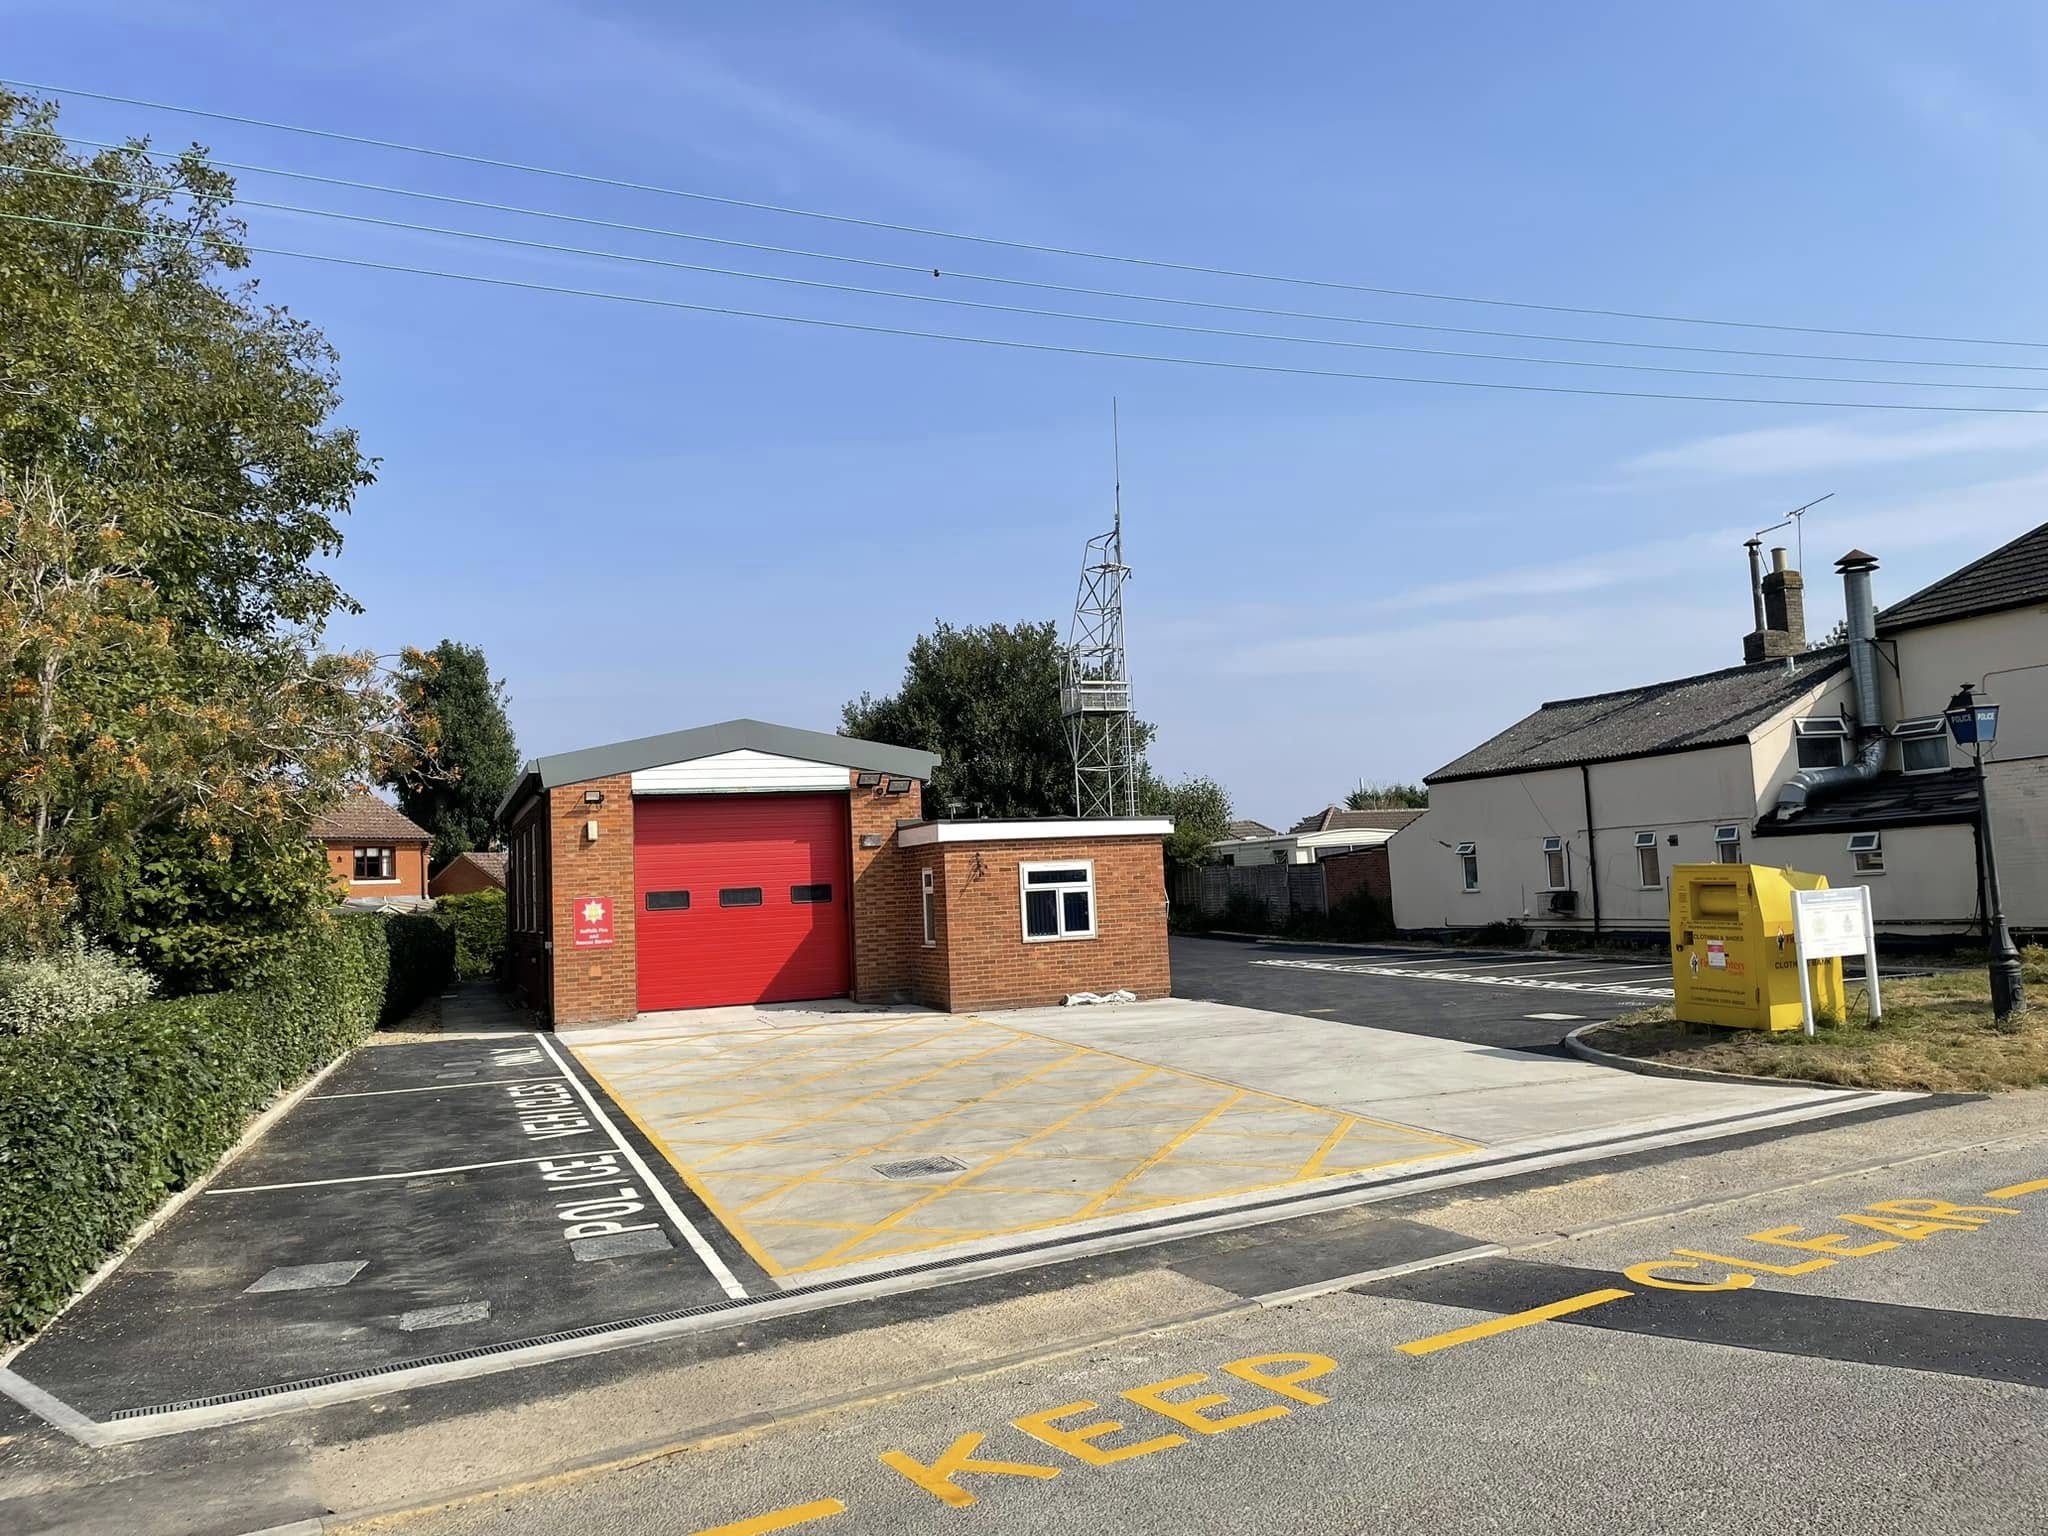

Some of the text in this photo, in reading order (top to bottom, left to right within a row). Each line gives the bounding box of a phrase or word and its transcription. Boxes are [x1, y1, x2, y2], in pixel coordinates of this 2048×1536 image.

[1952, 714, 1971, 723] POLICE
[1977, 712, 1995, 720] POLICE
[489, 1046, 660, 1239] POLICE VEHICLES ONLY
[878, 1199, 2021, 1508] KEEP CLEAR
